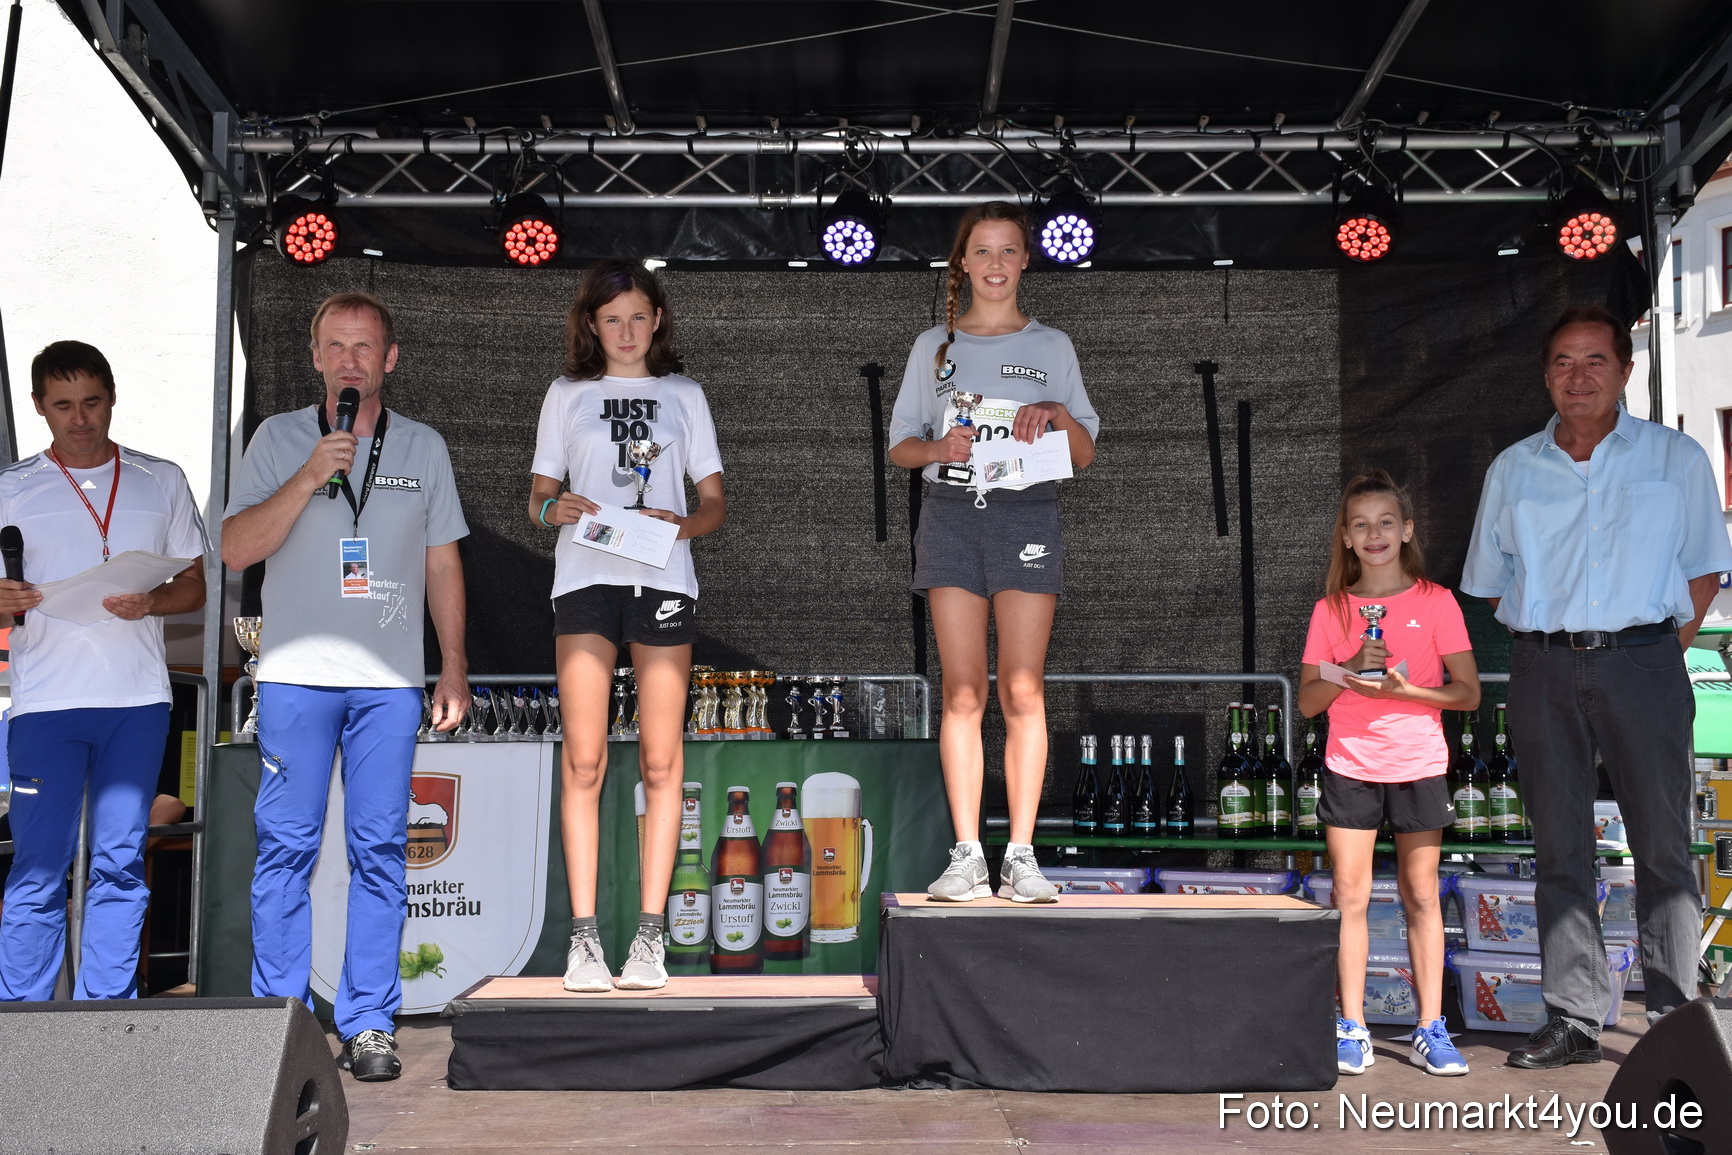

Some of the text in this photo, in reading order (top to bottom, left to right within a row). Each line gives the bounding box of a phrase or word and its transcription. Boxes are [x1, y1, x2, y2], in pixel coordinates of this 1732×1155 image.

[1001, 365, 1047, 383] BOCK
[600, 399, 659, 421] JUST
[975, 406, 1017, 419] BOCK
[611, 420, 650, 442] DO
[374, 475, 421, 489] BOCK
[1024, 544, 1046, 554] NIKE
[370, 580, 399, 590] markter
[660, 600, 681, 611] NIKE
[407, 846, 434, 859] 628
[406, 880, 464, 896] markter
[407, 896, 481, 918] msbräu
[770, 902, 800, 910] Zwickl
[720, 914, 754, 924] Urstoff
